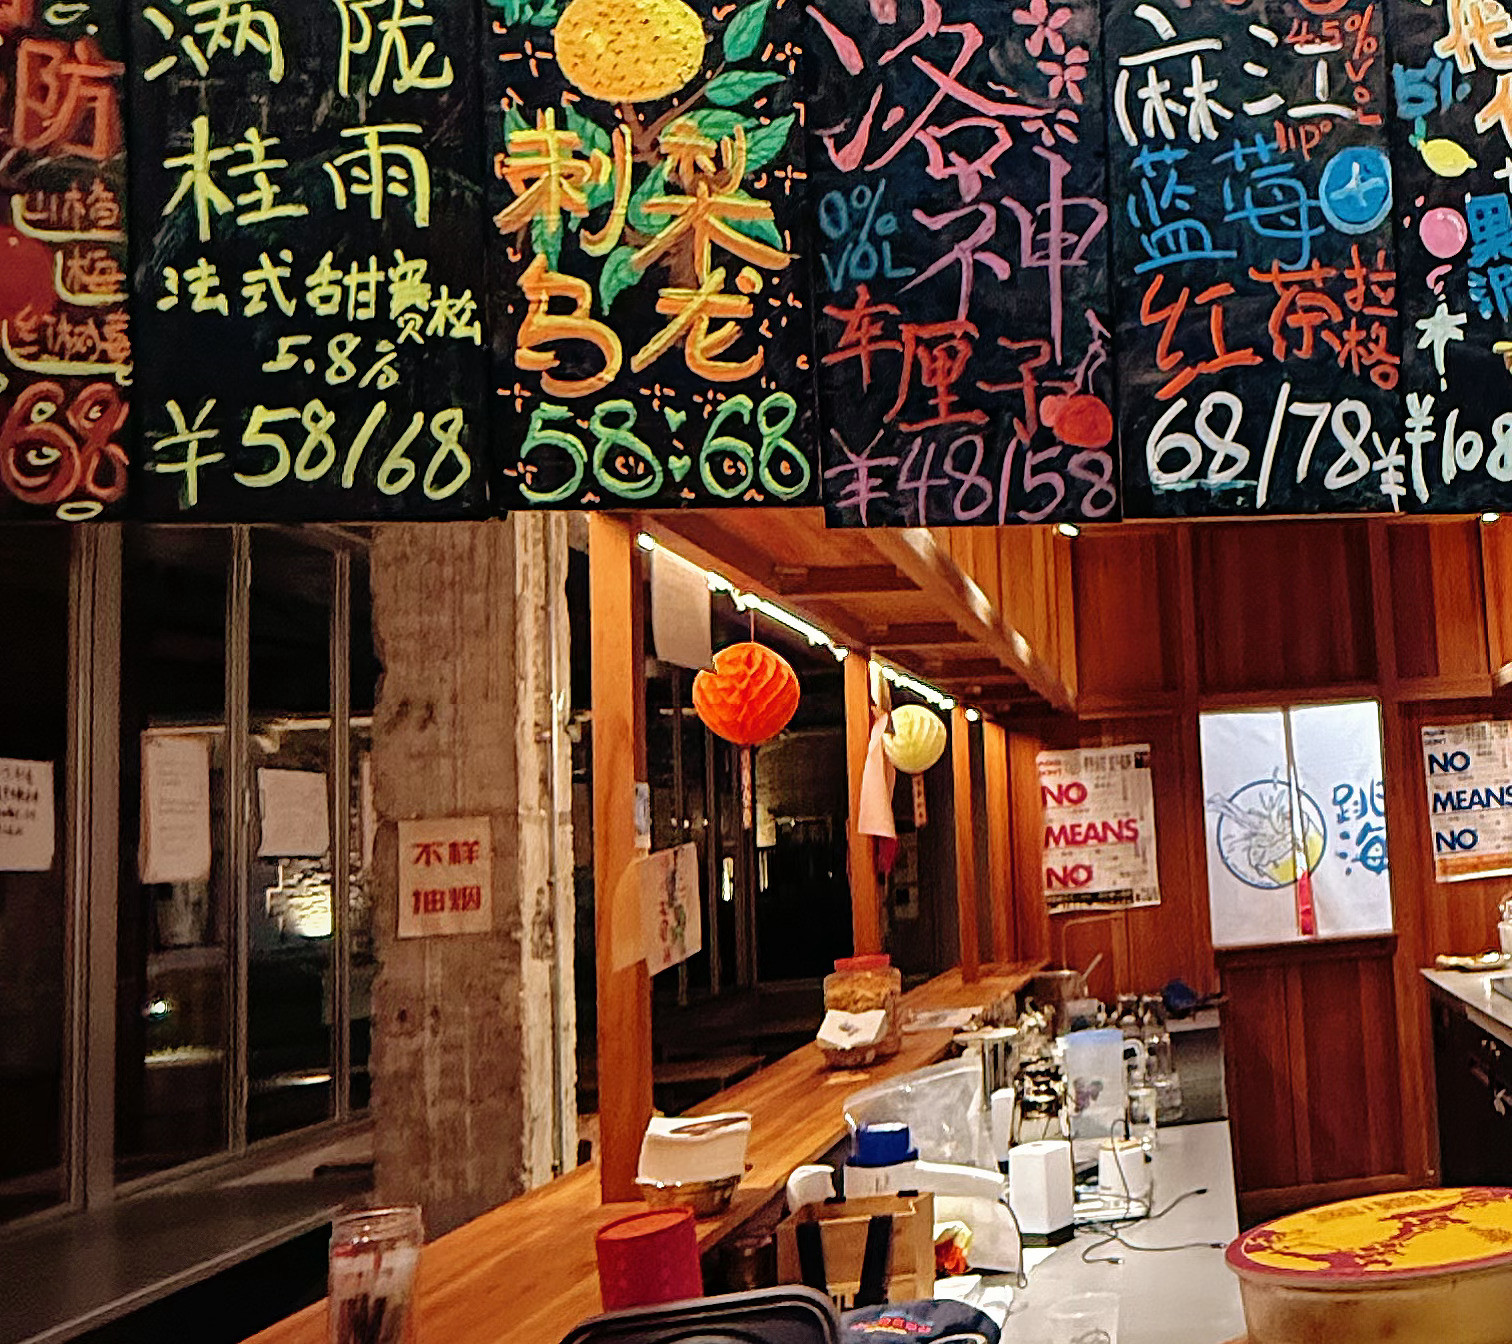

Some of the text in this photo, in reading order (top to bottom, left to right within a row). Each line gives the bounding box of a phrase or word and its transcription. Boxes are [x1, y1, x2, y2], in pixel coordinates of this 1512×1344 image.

[1428, 751, 1471, 774] NO
[1041, 782, 1088, 806] NO
[1044, 819, 1139, 848] MEANS
[1436, 829, 1479, 853] NO
[1046, 864, 1093, 889] NO
[413, 886, 481, 915] 抽烟
